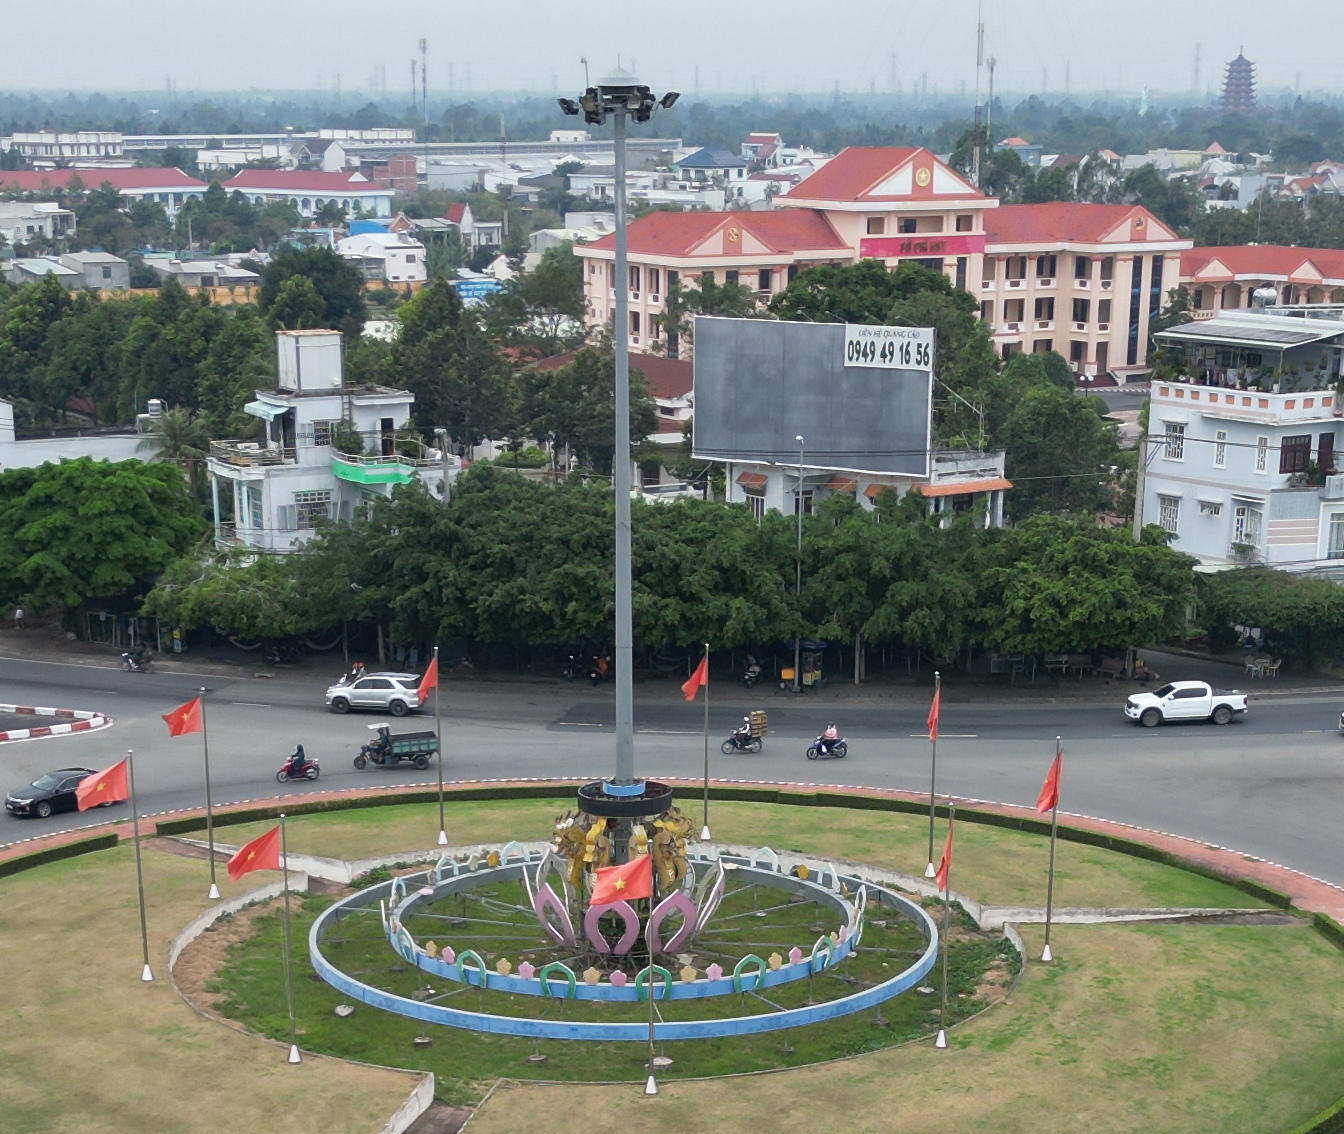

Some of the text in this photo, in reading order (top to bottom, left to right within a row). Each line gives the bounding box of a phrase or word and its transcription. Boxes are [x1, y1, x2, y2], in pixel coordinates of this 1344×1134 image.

[858, 328, 872, 337] LIÊN
[847, 339, 930, 367] 0949 49 16 56
